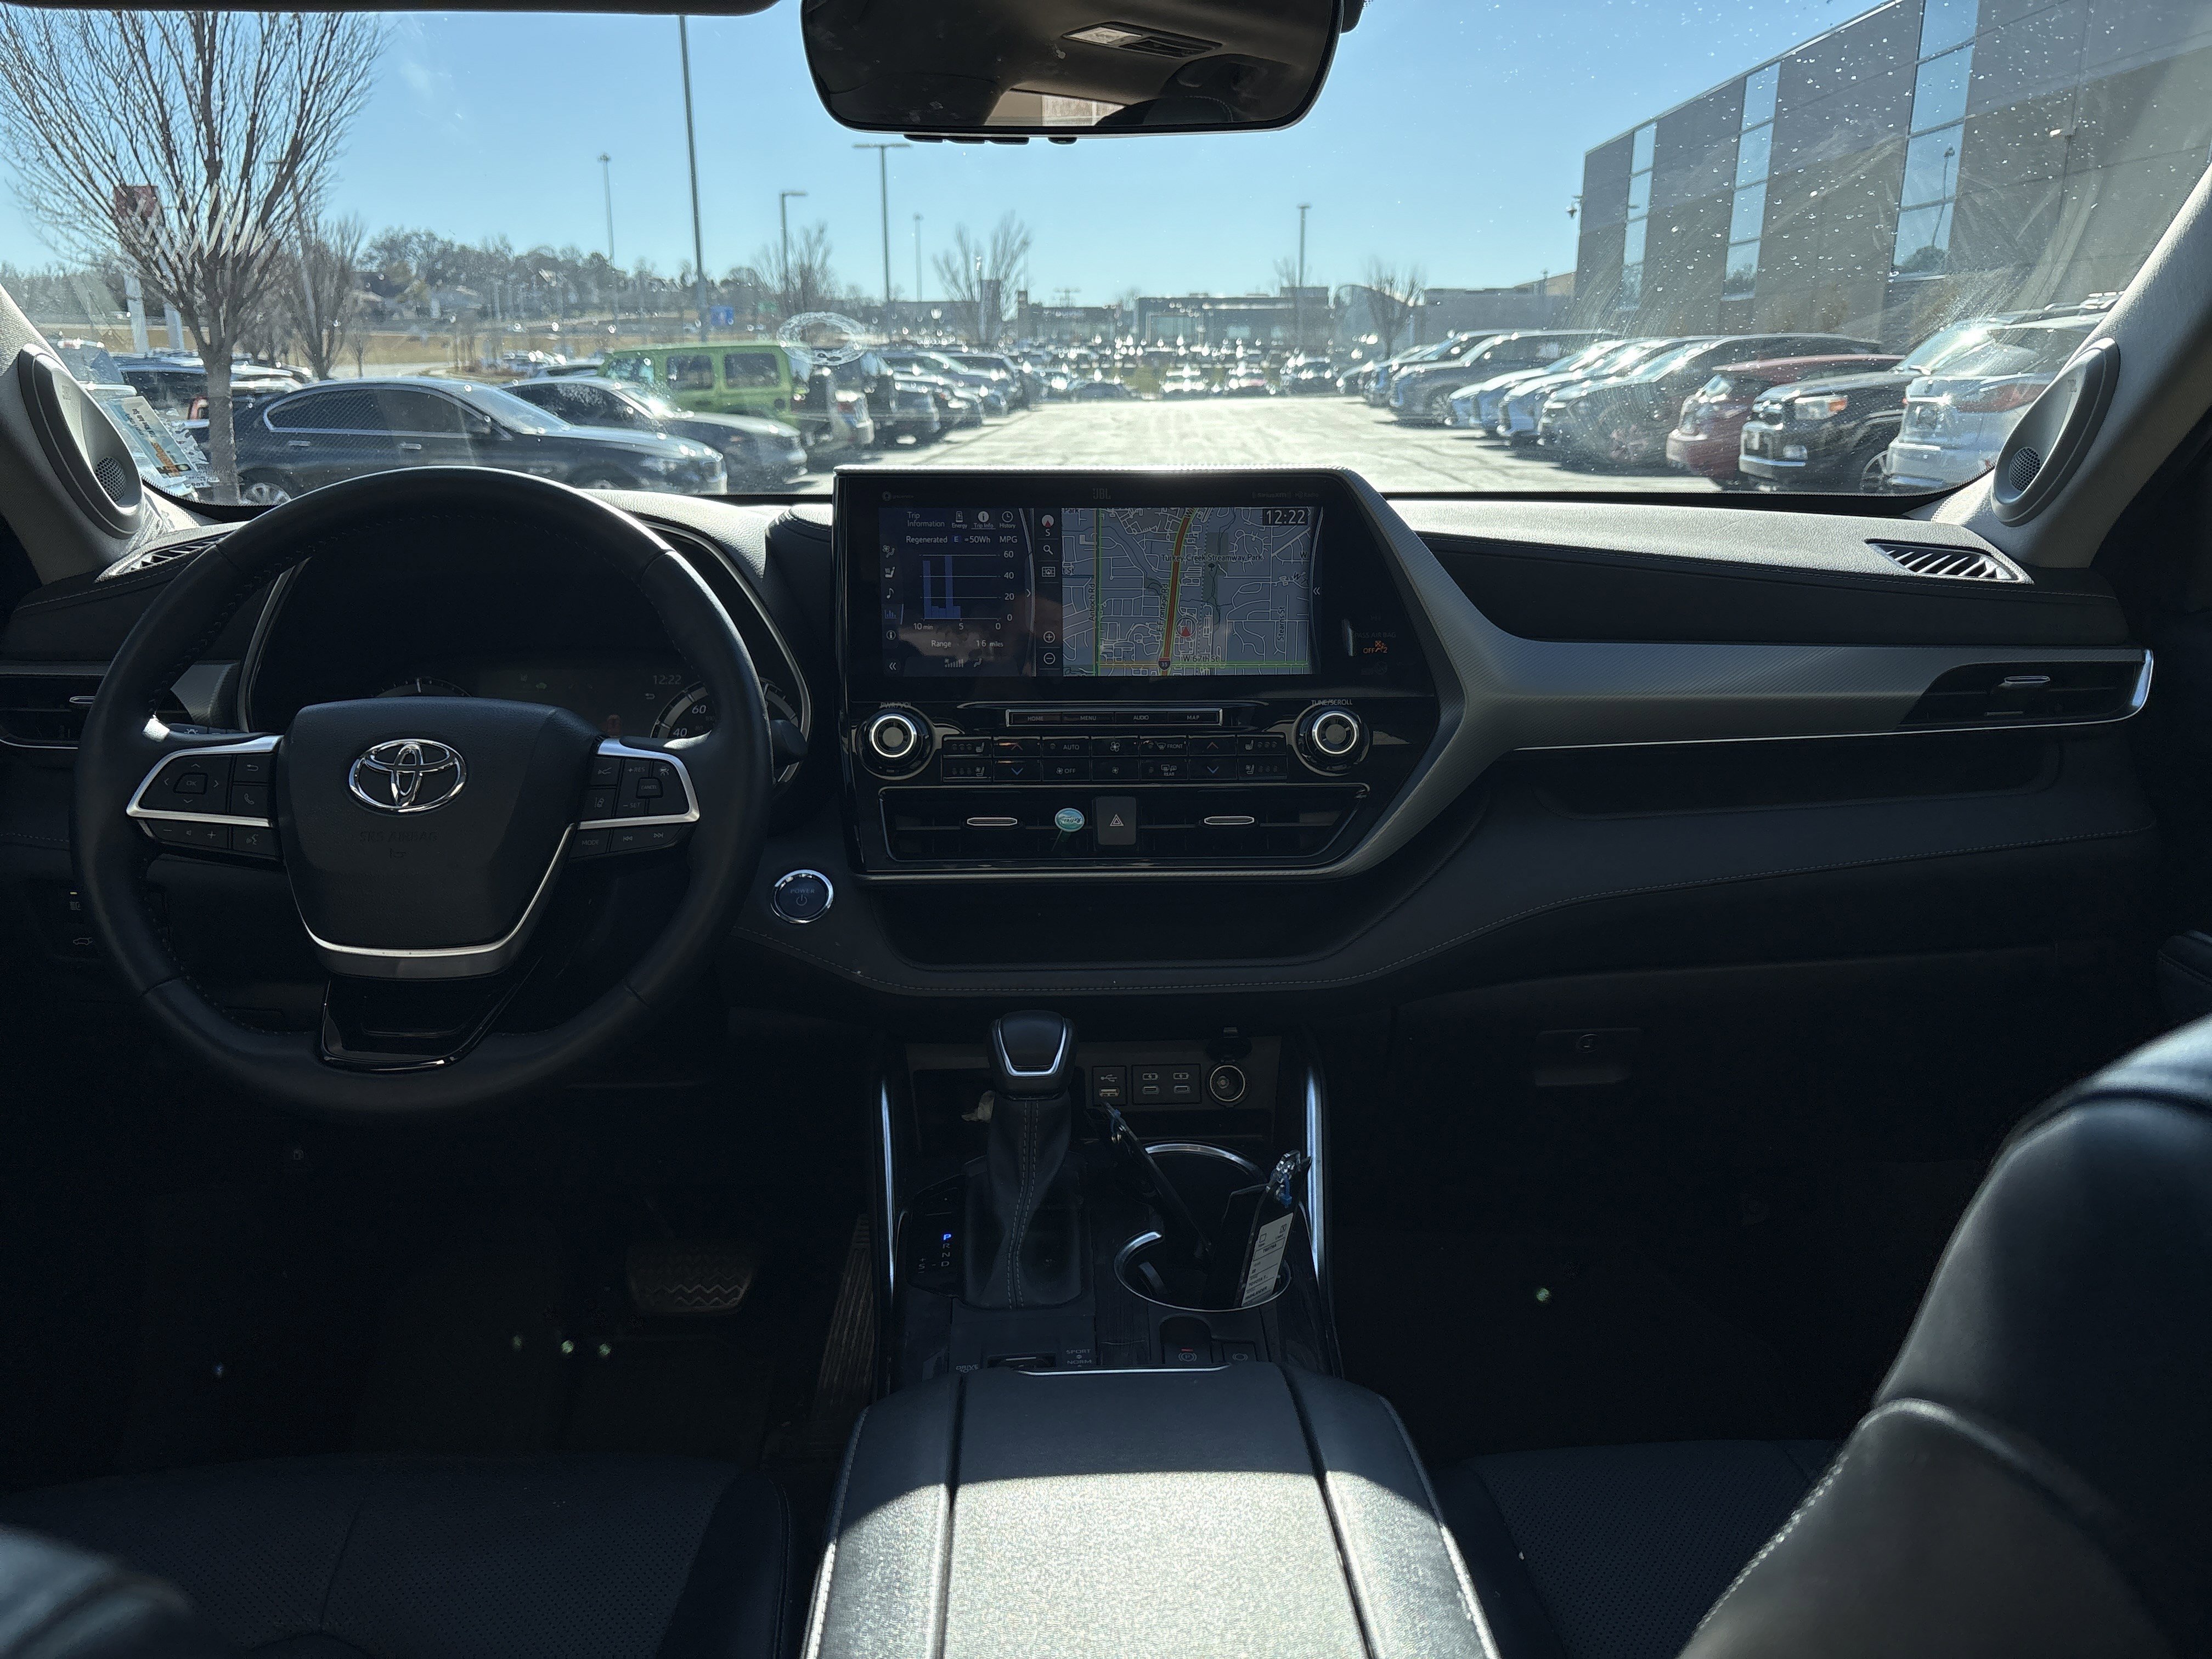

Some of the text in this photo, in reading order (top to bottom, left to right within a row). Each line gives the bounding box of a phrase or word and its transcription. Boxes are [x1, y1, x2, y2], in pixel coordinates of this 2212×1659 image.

[1092, 487, 1111, 500] JBL
[907, 511, 921, 520] Trip
[1266, 510, 1306, 524] 12:22
[1045, 528, 1051, 537] S
[906, 535, 948, 545] Regenerated
[999, 535, 1018, 544] MPG
[1003, 550, 1014, 558] 60
[1003, 571, 1014, 579] 40
[1088, 583, 1096, 593] Rd
[1161, 583, 1169, 594] Rd
[1157, 594, 1169, 627] Frontage
[913, 622, 922, 630] 10
[958, 622, 964, 630] 5
[1277, 614, 1285, 641] Stearns
[931, 640, 952, 648] Range
[652, 674, 682, 685] 12:22
[691, 704, 707, 714] 60
[673, 727, 689, 737] 40
